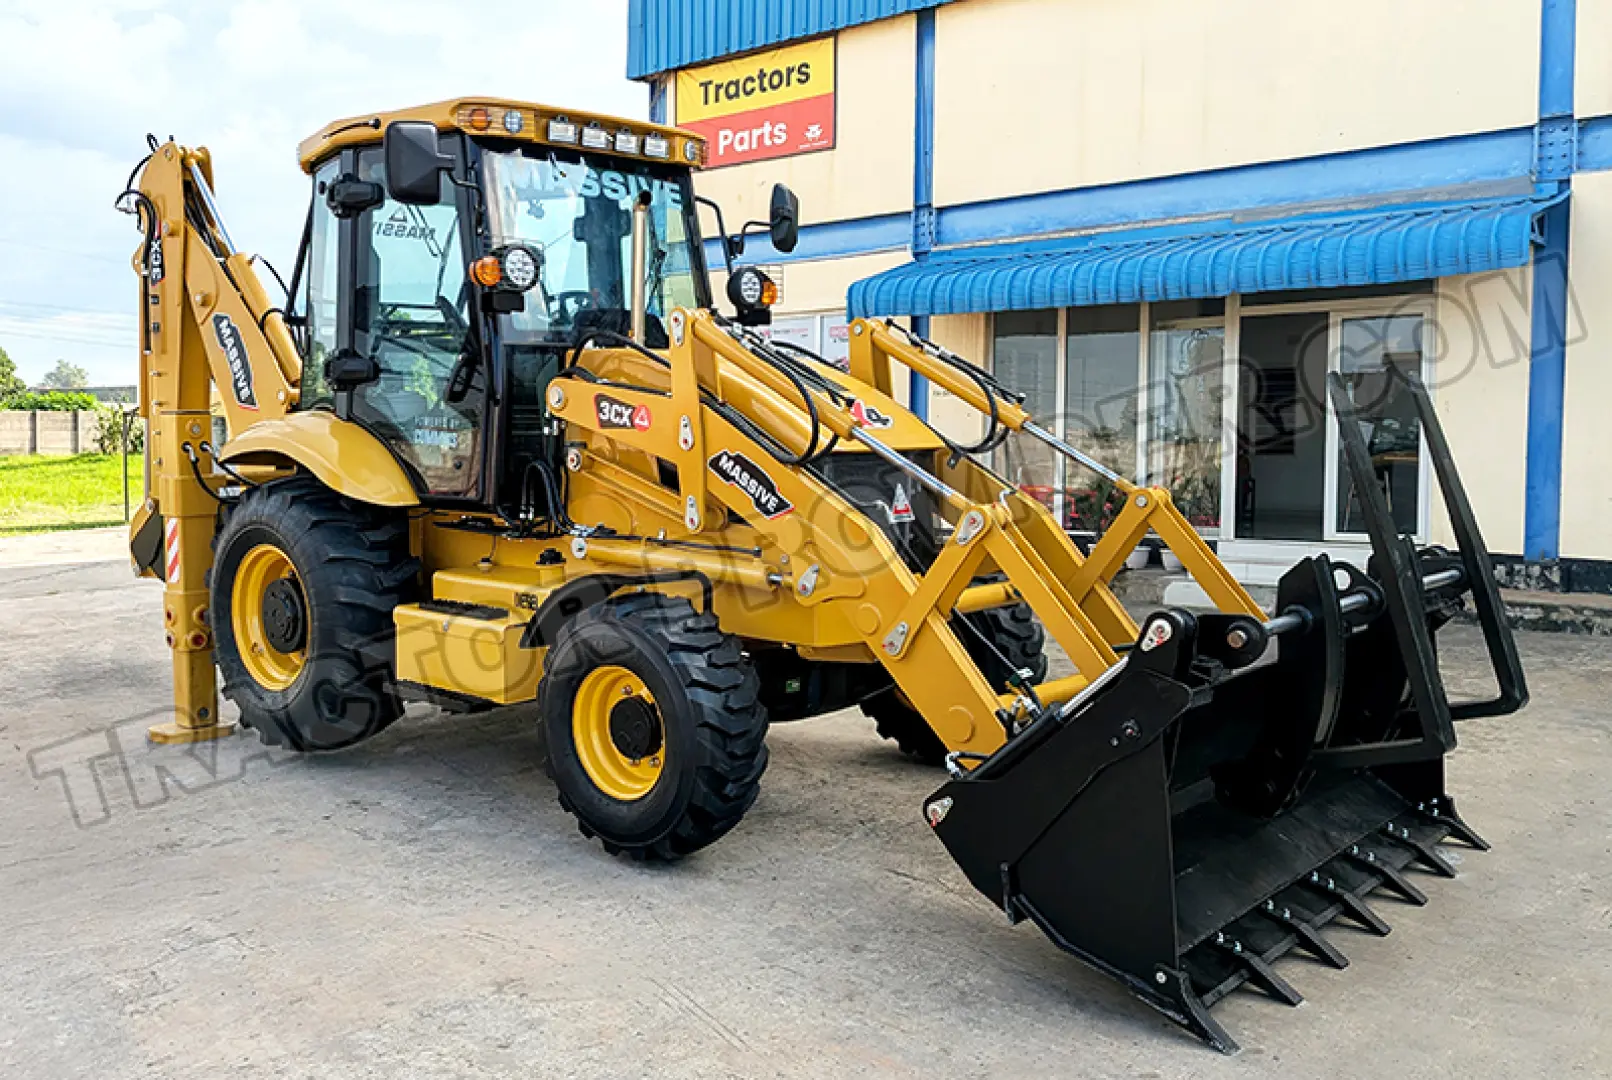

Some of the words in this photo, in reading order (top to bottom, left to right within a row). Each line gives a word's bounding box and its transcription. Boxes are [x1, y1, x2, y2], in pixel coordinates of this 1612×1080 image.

[699, 62, 811, 106] Tractors
[718, 120, 788, 156] Parts
[219, 318, 251, 401] MASSIVE
[598, 400, 633, 428] 3CX
[718, 453, 779, 513] MASSIVE
